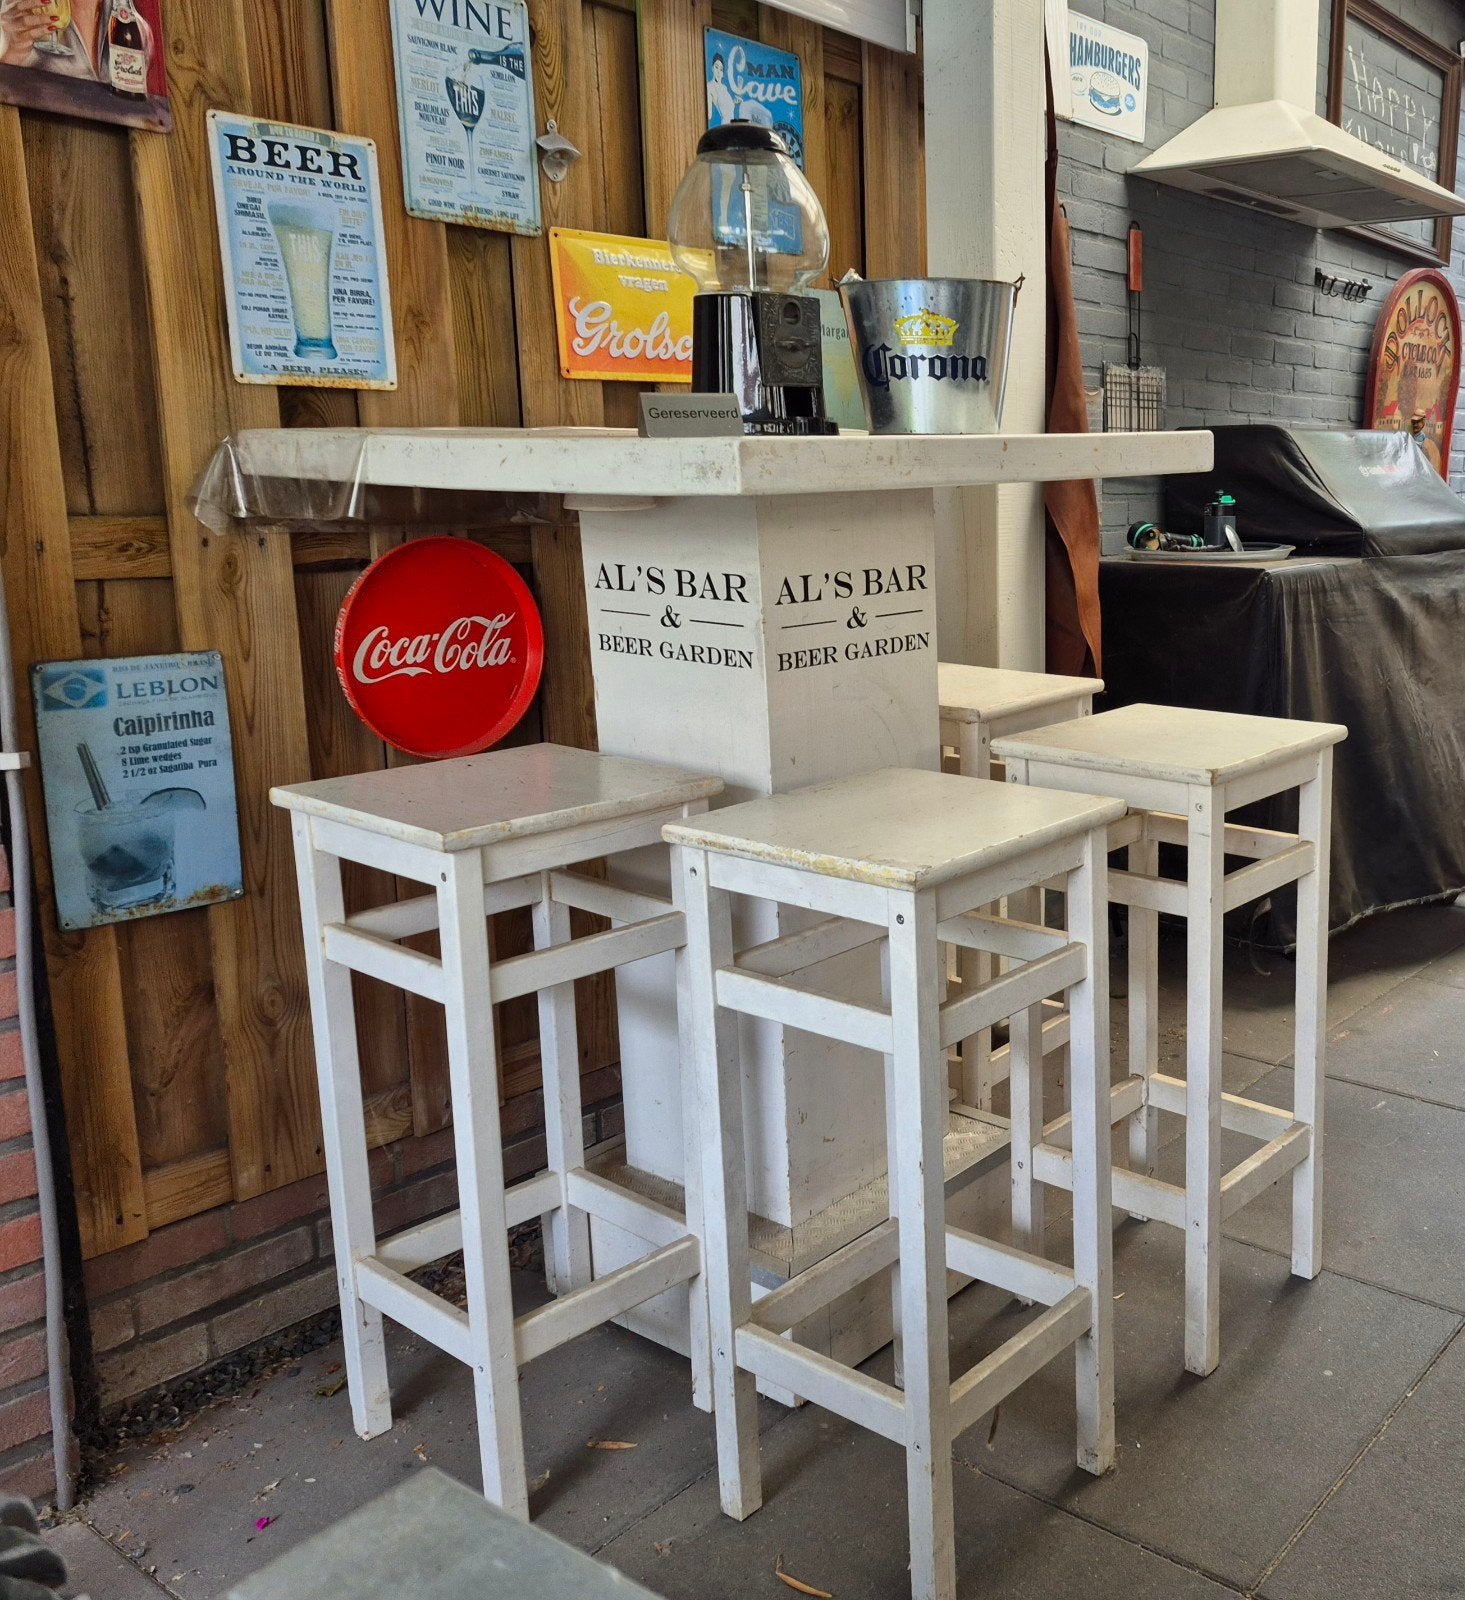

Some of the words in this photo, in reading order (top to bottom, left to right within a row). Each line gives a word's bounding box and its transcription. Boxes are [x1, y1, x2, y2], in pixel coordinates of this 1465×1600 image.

[415, 0, 513, 41] WINE
[407, 34, 440, 49] SAUVIGNON
[440, 42, 458, 55] BLANC
[499, 55, 507, 68] IS
[510, 57, 524, 72] THE
[746, 61, 794, 80] MAN
[1070, 32, 1141, 91] HAMBURGERS
[727, 45, 798, 105] Cave
[453, 82, 479, 116] THIS
[1347, 45, 1436, 149] HAPPY
[223, 133, 361, 180] BEER
[426, 152, 446, 166] PINOT
[448, 157, 465, 170] NOIR
[227, 165, 284, 183] AROUND
[289, 174, 316, 187] THE
[321, 179, 366, 193] WORLD
[428, 199, 442, 208] GOOD
[443, 201, 456, 210] WINE
[502, 190, 520, 199] SYRAH
[618, 274, 669, 293] vragen
[568, 295, 693, 361] Grolsc
[1384, 289, 1451, 377] POLLOCK
[1402, 342, 1426, 361] CYCLE
[282, 364, 315, 376] BEER,
[862, 342, 988, 391] Corona
[648, 407, 739, 420] Gereserveerd
[595, 563, 666, 596] AL'S
[674, 569, 750, 604] BAR
[775, 571, 854, 606] AL'S
[862, 564, 928, 597] BAR
[660, 605, 682, 628] &
[846, 606, 868, 629] &
[353, 612, 516, 684] Coca-Cola
[598, 634, 654, 657] BEER
[659, 641, 754, 669] GARDEN
[777, 646, 839, 672] BEER
[845, 632, 930, 661] GARDEN
[116, 675, 218, 700] LEBLON
[113, 709, 215, 737] Caipirinha
[120, 745, 127, 755] 2
[142, 738, 188, 752] Granulated
[190, 736, 213, 748] Sugar
[129, 754, 149, 766] Lime
[151, 751, 182, 765] wedges
[122, 769, 128, 779] 2
[130, 766, 146, 778] 1/2
[198, 758, 217, 769] Pura
